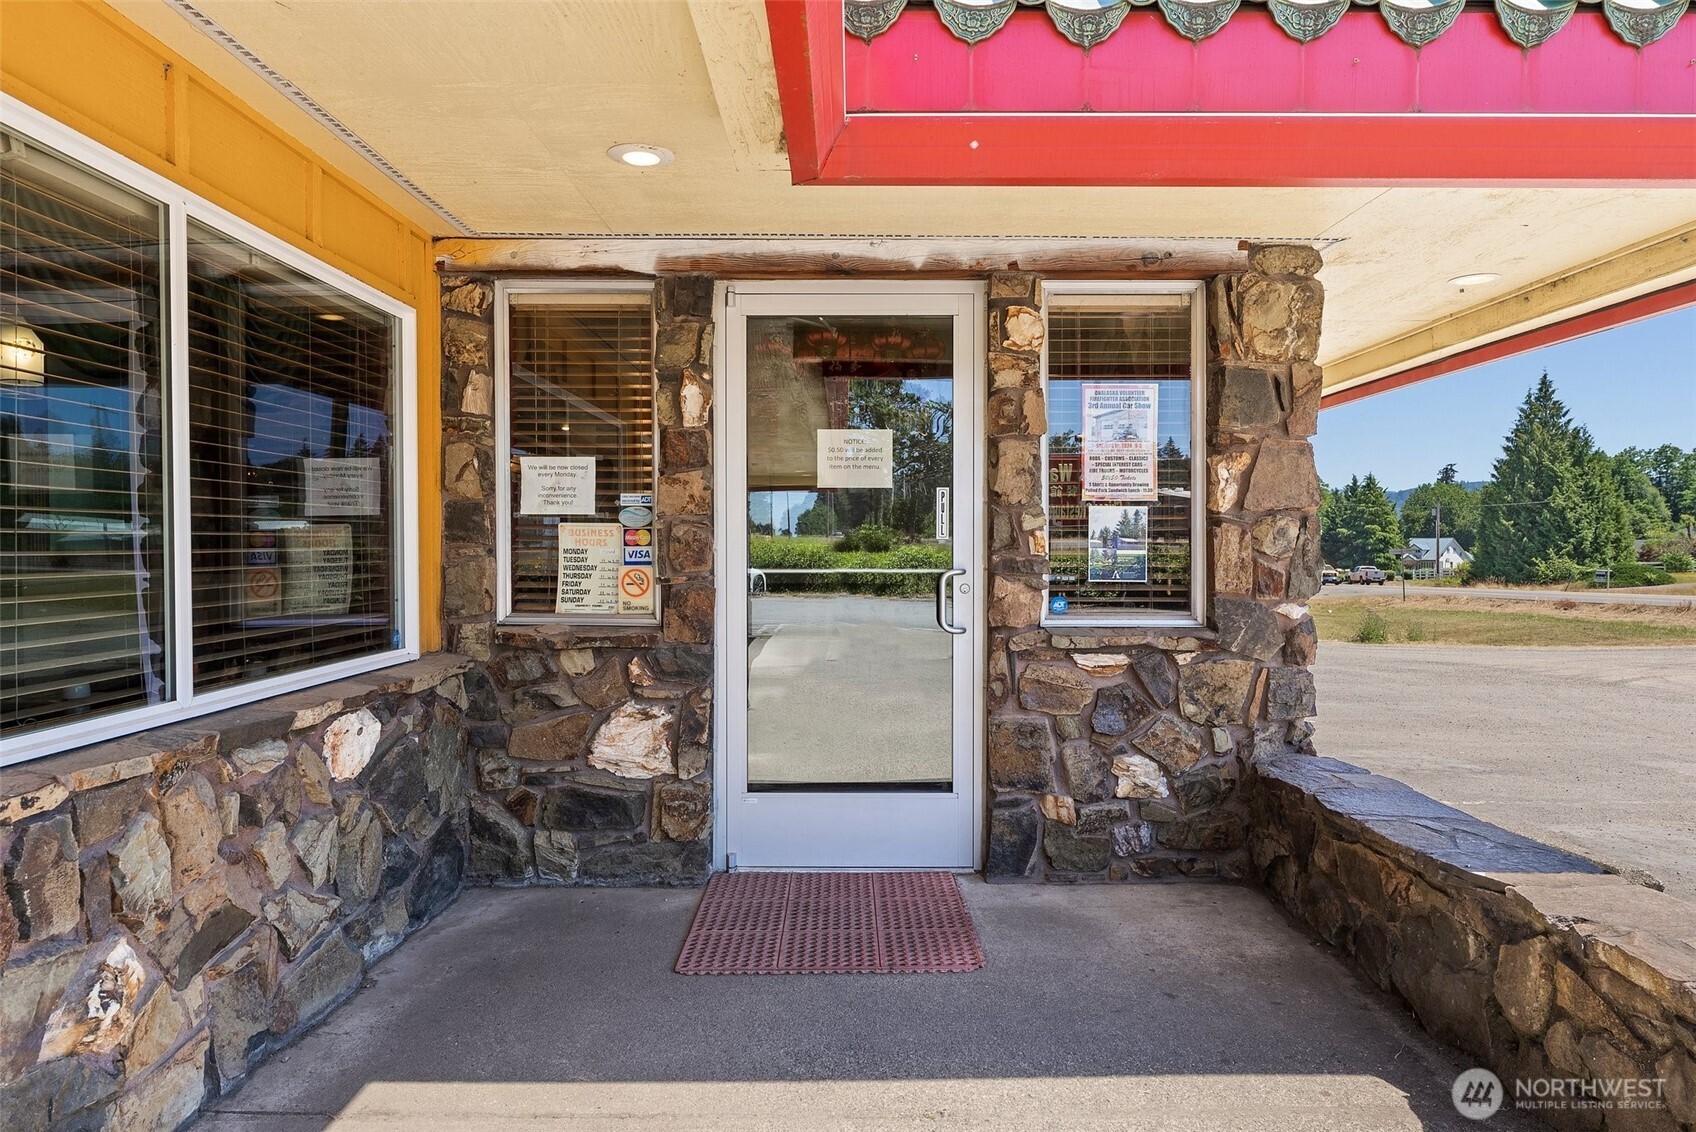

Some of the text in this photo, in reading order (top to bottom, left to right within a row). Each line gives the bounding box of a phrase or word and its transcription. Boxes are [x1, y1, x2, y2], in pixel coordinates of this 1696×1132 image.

[568, 528, 614, 537] BUSINESS
[575, 538, 608, 547] HOURS
[628, 550, 650, 559] VISA
